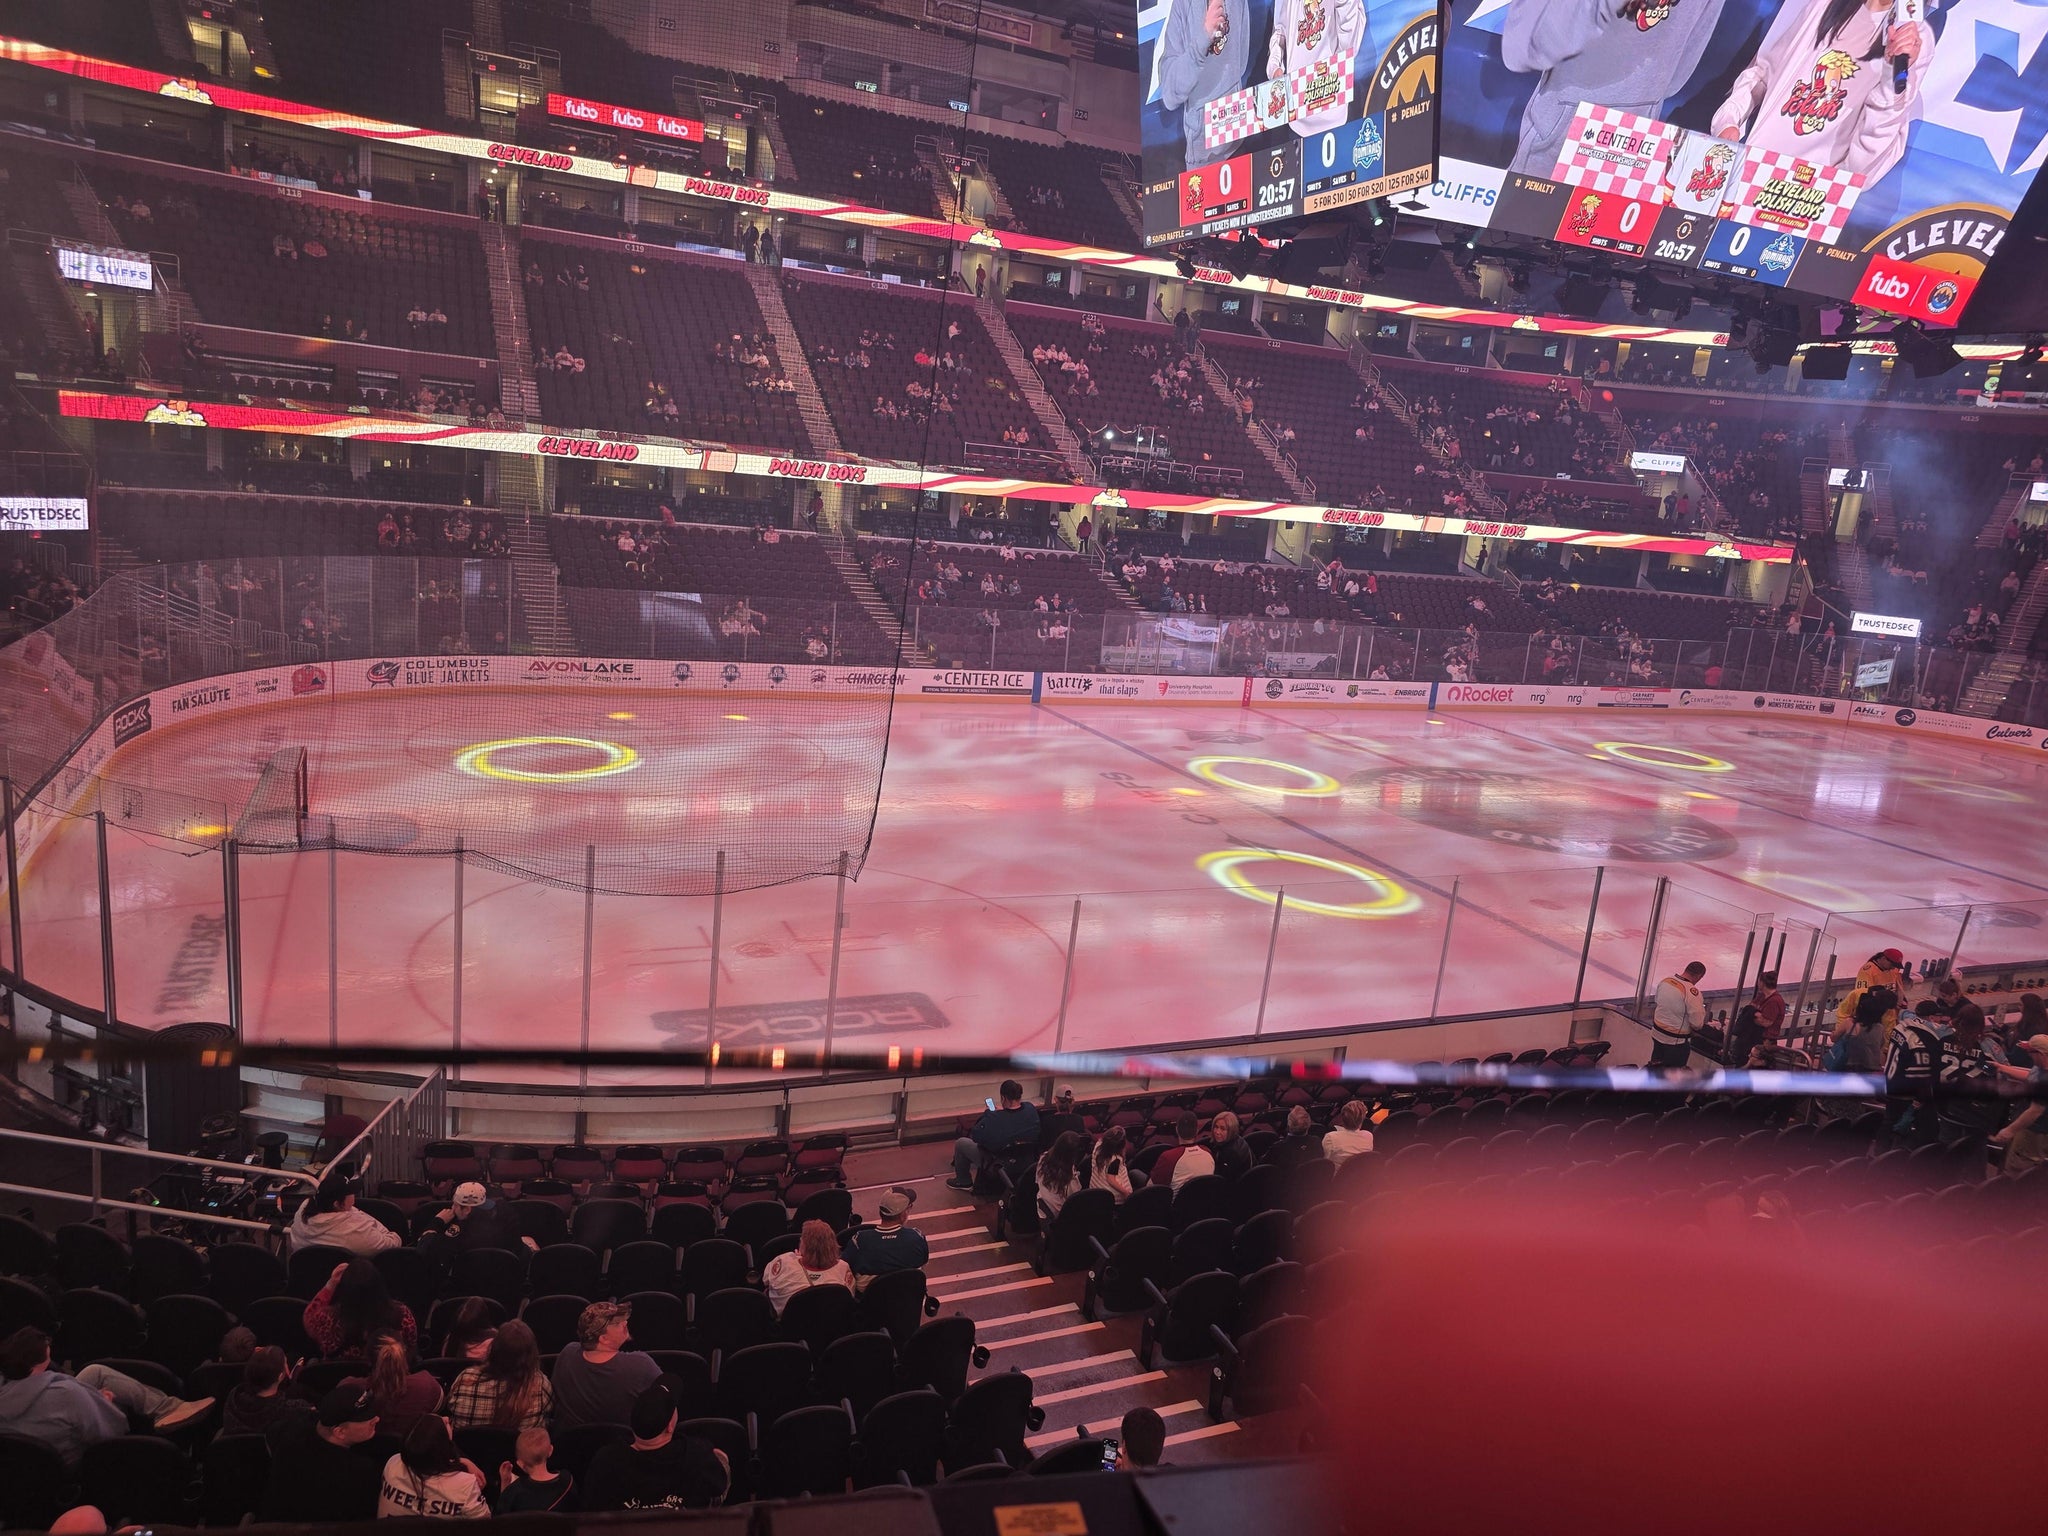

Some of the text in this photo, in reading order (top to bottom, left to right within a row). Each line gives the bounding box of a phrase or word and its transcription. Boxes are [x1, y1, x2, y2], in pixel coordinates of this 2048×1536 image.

[660, 19, 675, 29] 222
[764, 42, 780, 53] 223
[476, 53, 488, 62] 221
[518, 62, 531, 70] 222
[1305, 71, 1338, 92] CLEVELAND
[1304, 86, 1324, 104] POLISH
[1322, 81, 1341, 97] BOYS
[566, 100, 598, 120] fubo
[612, 109, 644, 128] fubo
[1075, 110, 1088, 120] 224
[1401, 100, 1431, 121] PENALTY
[657, 118, 688, 137] fubo
[1322, 132, 1336, 168] 0
[1596, 130, 1656, 156] CENTER ICE
[487, 142, 574, 172] CLEVELAND
[1152, 180, 1176, 194] PENALTY
[1219, 164, 1232, 196] 0
[1388, 169, 1429, 190] 125 FOR $40
[1524, 180, 1556, 195] PENALTY
[684, 178, 770, 205] POLISH BOYS
[1258, 178, 1295, 206] 20:57
[1314, 192, 1344, 208] 5 FOR $10
[1348, 182, 1384, 200] 50 FOR $20
[1431, 180, 1498, 207] CLIFFS
[1764, 178, 1826, 204] CLEVELAND
[1754, 192, 1826, 220] POLISH BOYS
[1619, 202, 1641, 234] 0
[1166, 230, 1185, 241] RAFFLE
[1728, 226, 1751, 257] 0
[1654, 239, 1697, 262] 20:57
[1826, 248, 1857, 262] PENALTY
[96, 264, 148, 281] CLIFFS
[1868, 271, 1910, 299] fubo
[1306, 284, 1364, 306] POLISH BOYS
[538, 436, 640, 462] CLEVELAND
[768, 458, 866, 484] POLISH BOYS
[1651, 458, 1682, 469] CLIFFS
[1, 508, 81, 520] RUSTEDSEC
[1322, 508, 1384, 528] CLEVELAND
[1463, 520, 1527, 538] POLISH BOYS
[1858, 618, 1914, 633] TRUSTEDSEC
[406, 659, 490, 670] COLUMBUS
[406, 670, 490, 684] BLUE JACKETS
[944, 672, 1025, 687] CENTER ICE
[1099, 684, 1139, 698] that slaps
[1394, 689, 1427, 697] ENBRIDGE
[1462, 686, 1514, 702] Rocket
[1530, 692, 1546, 704] nrg
[1566, 694, 1583, 706] nrg
[172, 697, 190, 714] FAN
[191, 688, 231, 710] SALUTE
[1768, 701, 1816, 712] MONSTERS HOCKEY
[1986, 724, 2033, 740] Culver's
[1914, 1052, 1930, 1064] 16
[382, 1481, 466, 1517] WEET SUE
